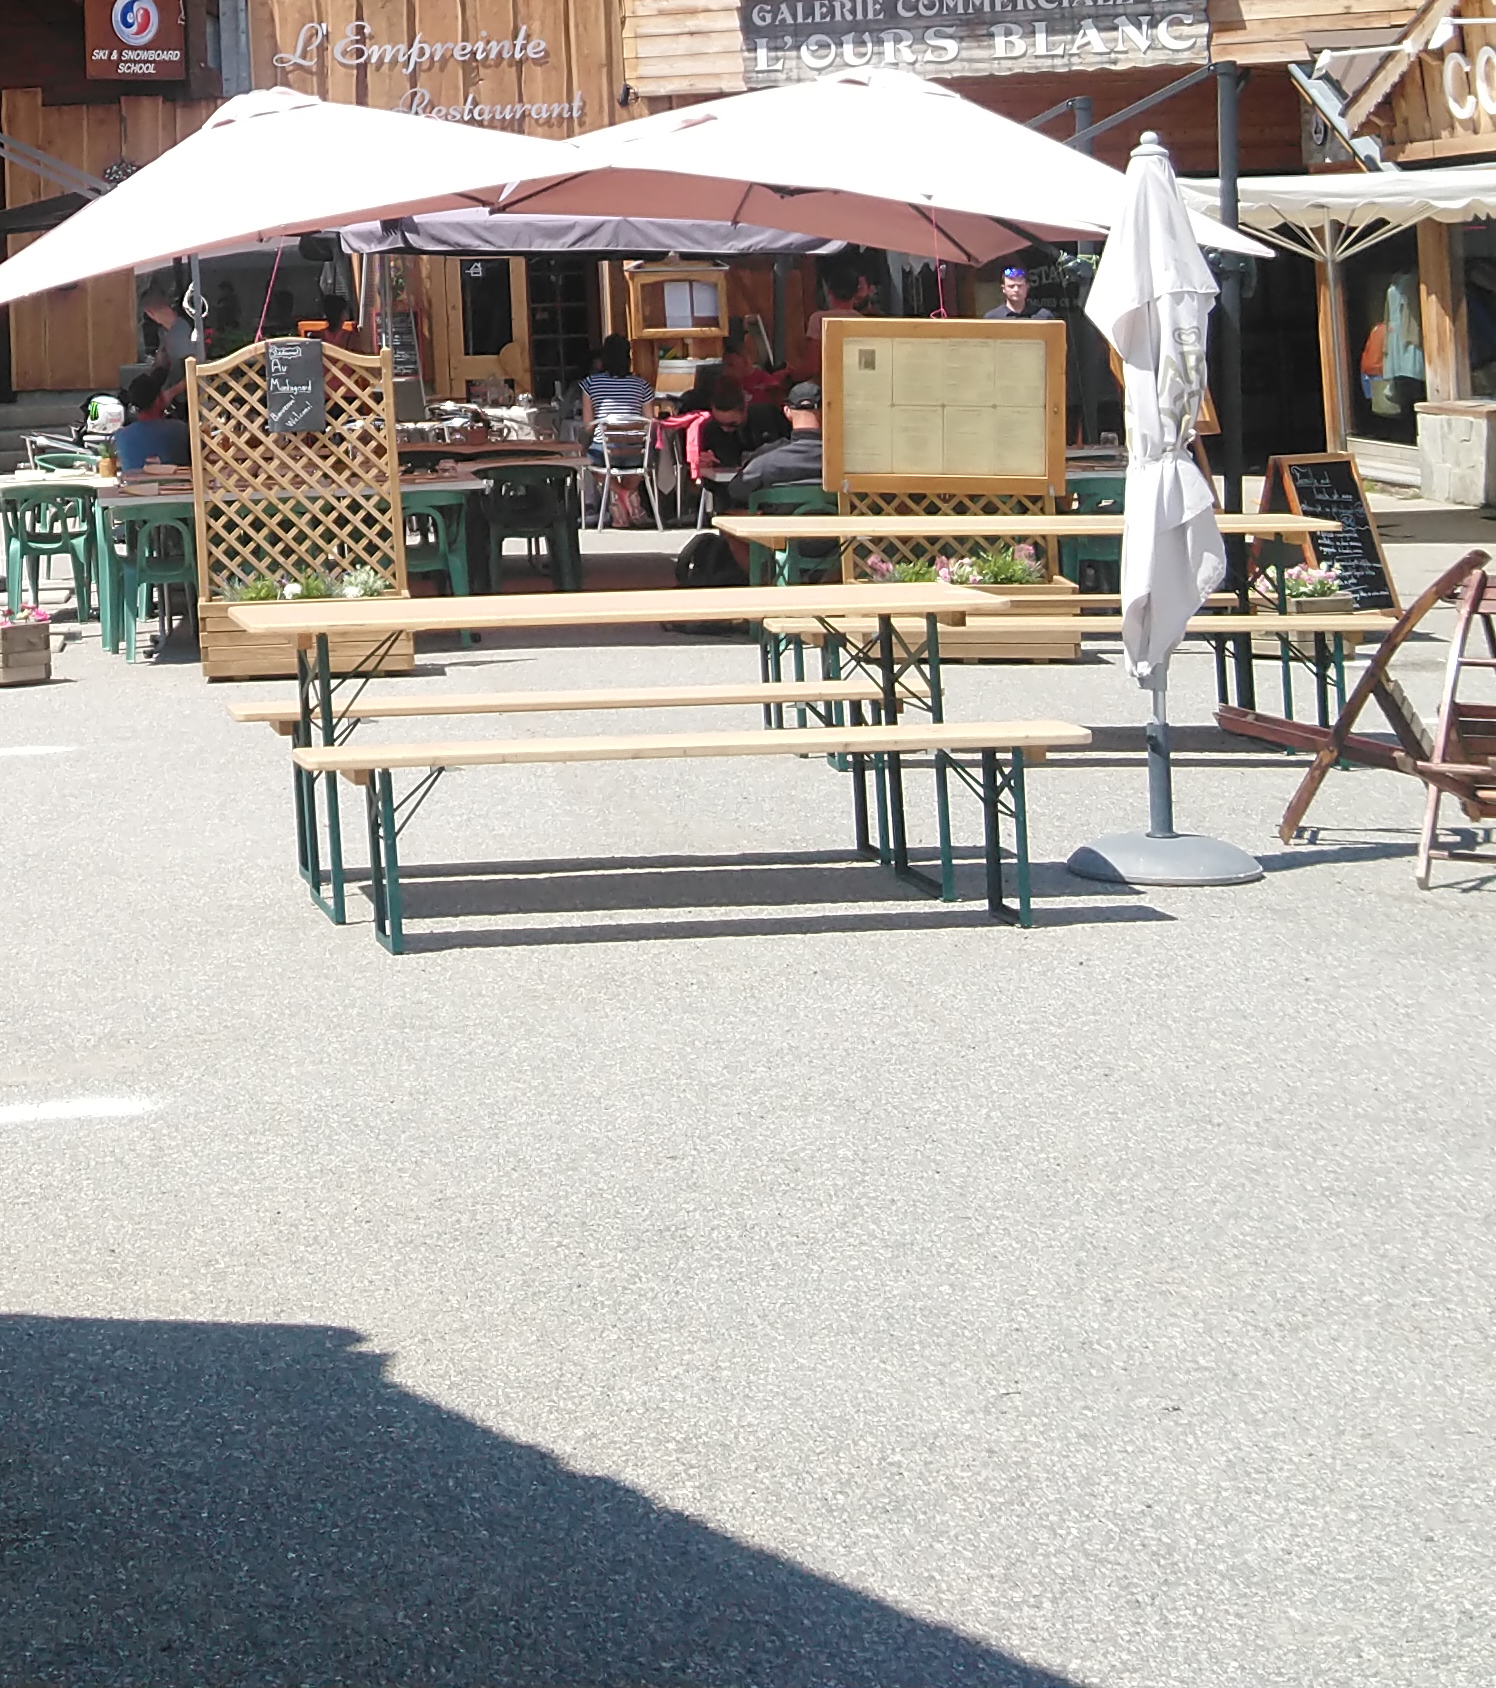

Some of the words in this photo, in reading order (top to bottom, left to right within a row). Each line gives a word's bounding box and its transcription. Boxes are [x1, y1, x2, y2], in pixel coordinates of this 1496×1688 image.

[91, 49, 109, 60] SKI
[110, 49, 119, 61] &
[121, 50, 181, 61] SNOWBOARD
[273, 21, 547, 75] L'Empreinte
[753, 25, 962, 72] L'OURS
[991, 13, 1197, 59] BLANC
[117, 63, 157, 74] SCHOOL
[393, 87, 583, 122] Restaurant
[271, 358, 288, 373] Au
